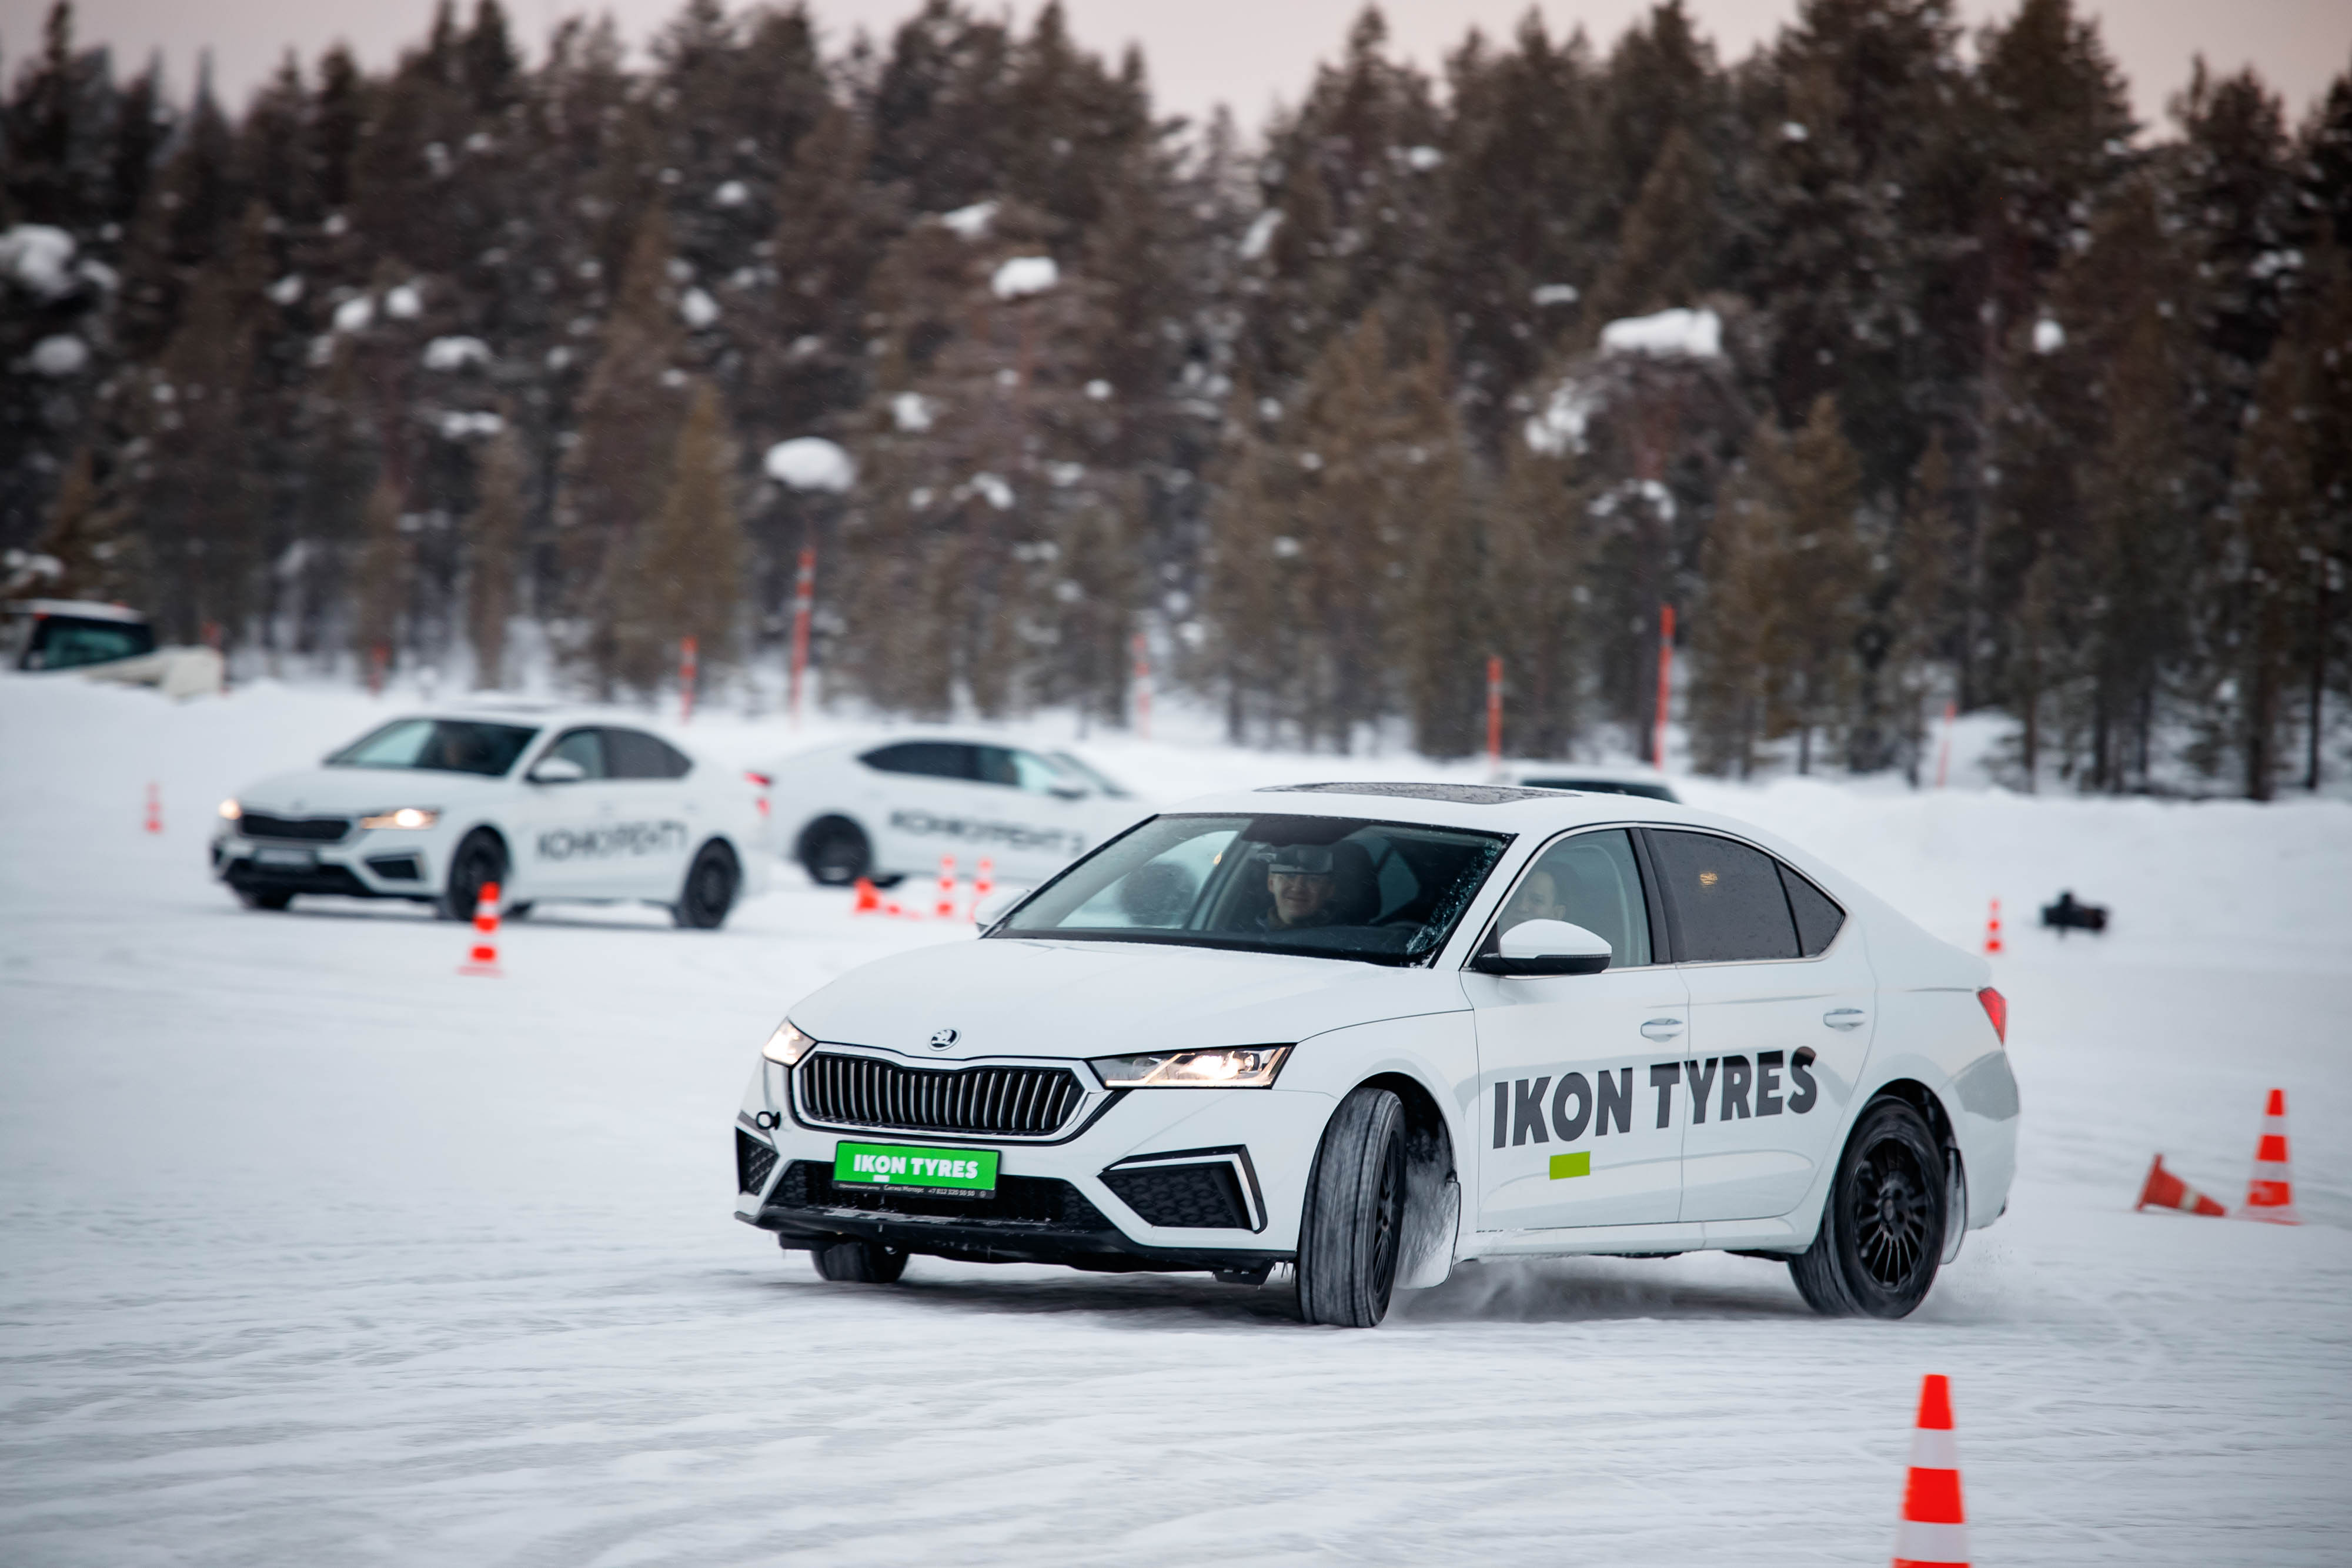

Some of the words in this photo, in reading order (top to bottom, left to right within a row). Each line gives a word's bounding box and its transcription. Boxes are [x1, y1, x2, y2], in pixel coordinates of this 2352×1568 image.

[1493, 1067, 1633, 1149] IKON
[1650, 1046, 1817, 1129] TYRES
[853, 1154, 907, 1175] IKON
[910, 1157, 979, 1179] TYRES
